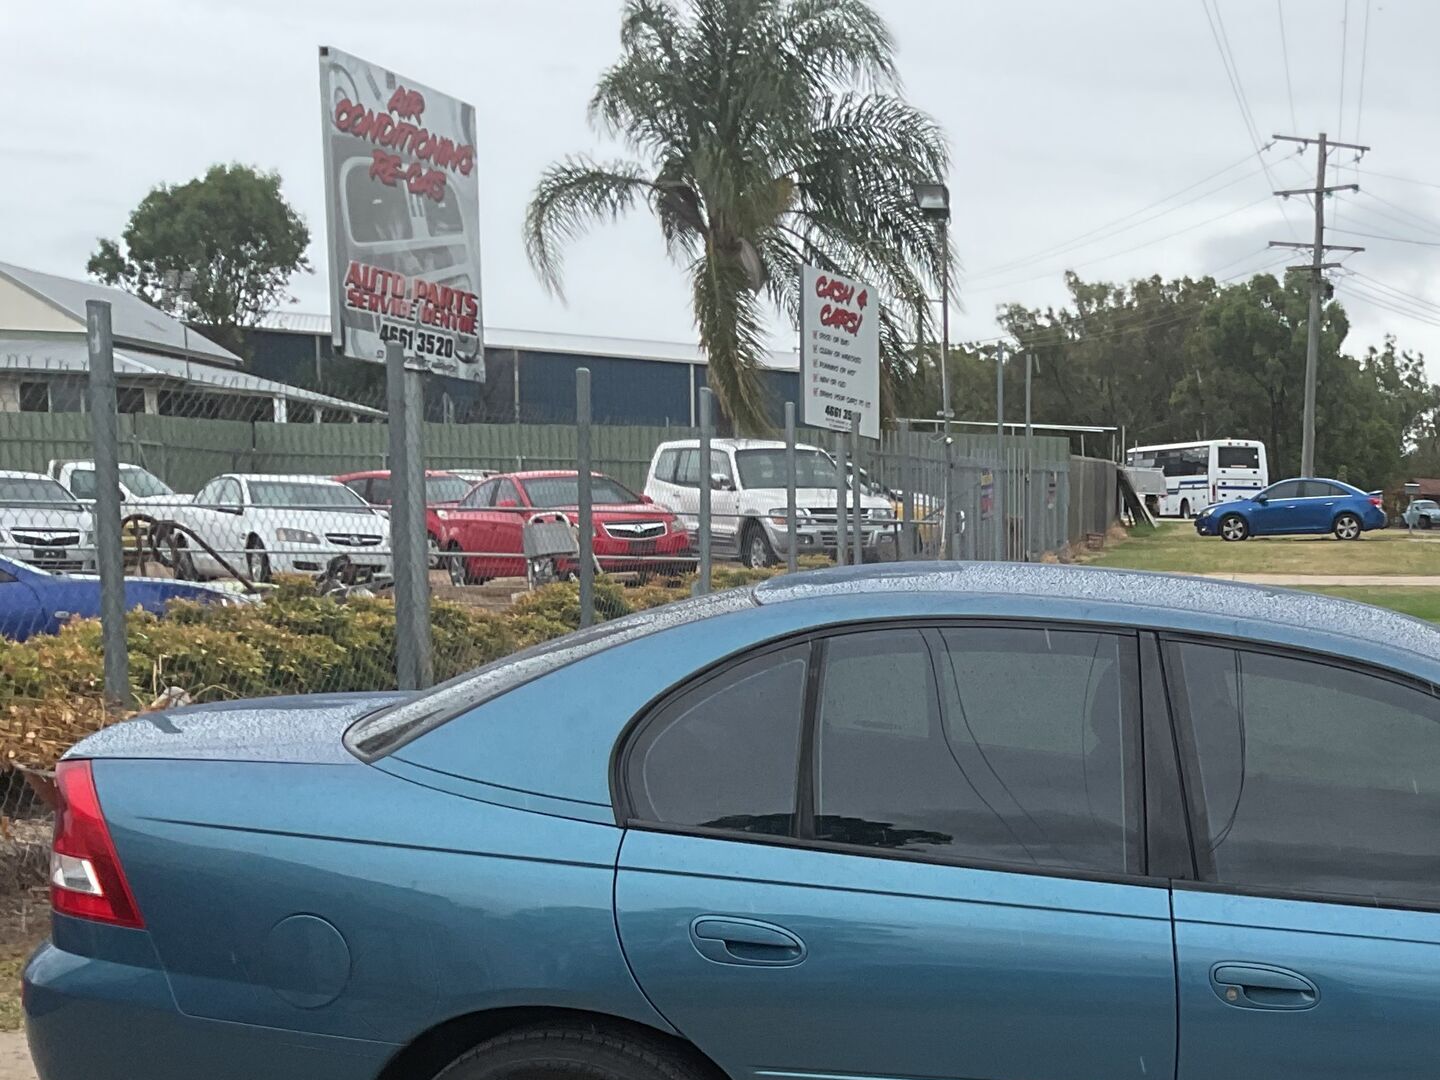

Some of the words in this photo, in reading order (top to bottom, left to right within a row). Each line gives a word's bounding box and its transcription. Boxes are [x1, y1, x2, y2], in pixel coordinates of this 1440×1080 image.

[387, 85, 425, 126] AIR
[335, 98, 473, 176] CONDITIONING
[369, 148, 446, 202] RE-GAS
[344, 261, 405, 298] AUTO
[413, 278, 479, 317] PARTS
[346, 288, 417, 321] SERVICE
[815, 275, 855, 307] CASH
[857, 289, 868, 311] 4
[820, 304, 863, 337] CARS!
[379, 323, 414, 350] 4661
[416, 332, 454, 359] 3520
[825, 405, 841, 418] 4661
[843, 409, 861, 423] 35
